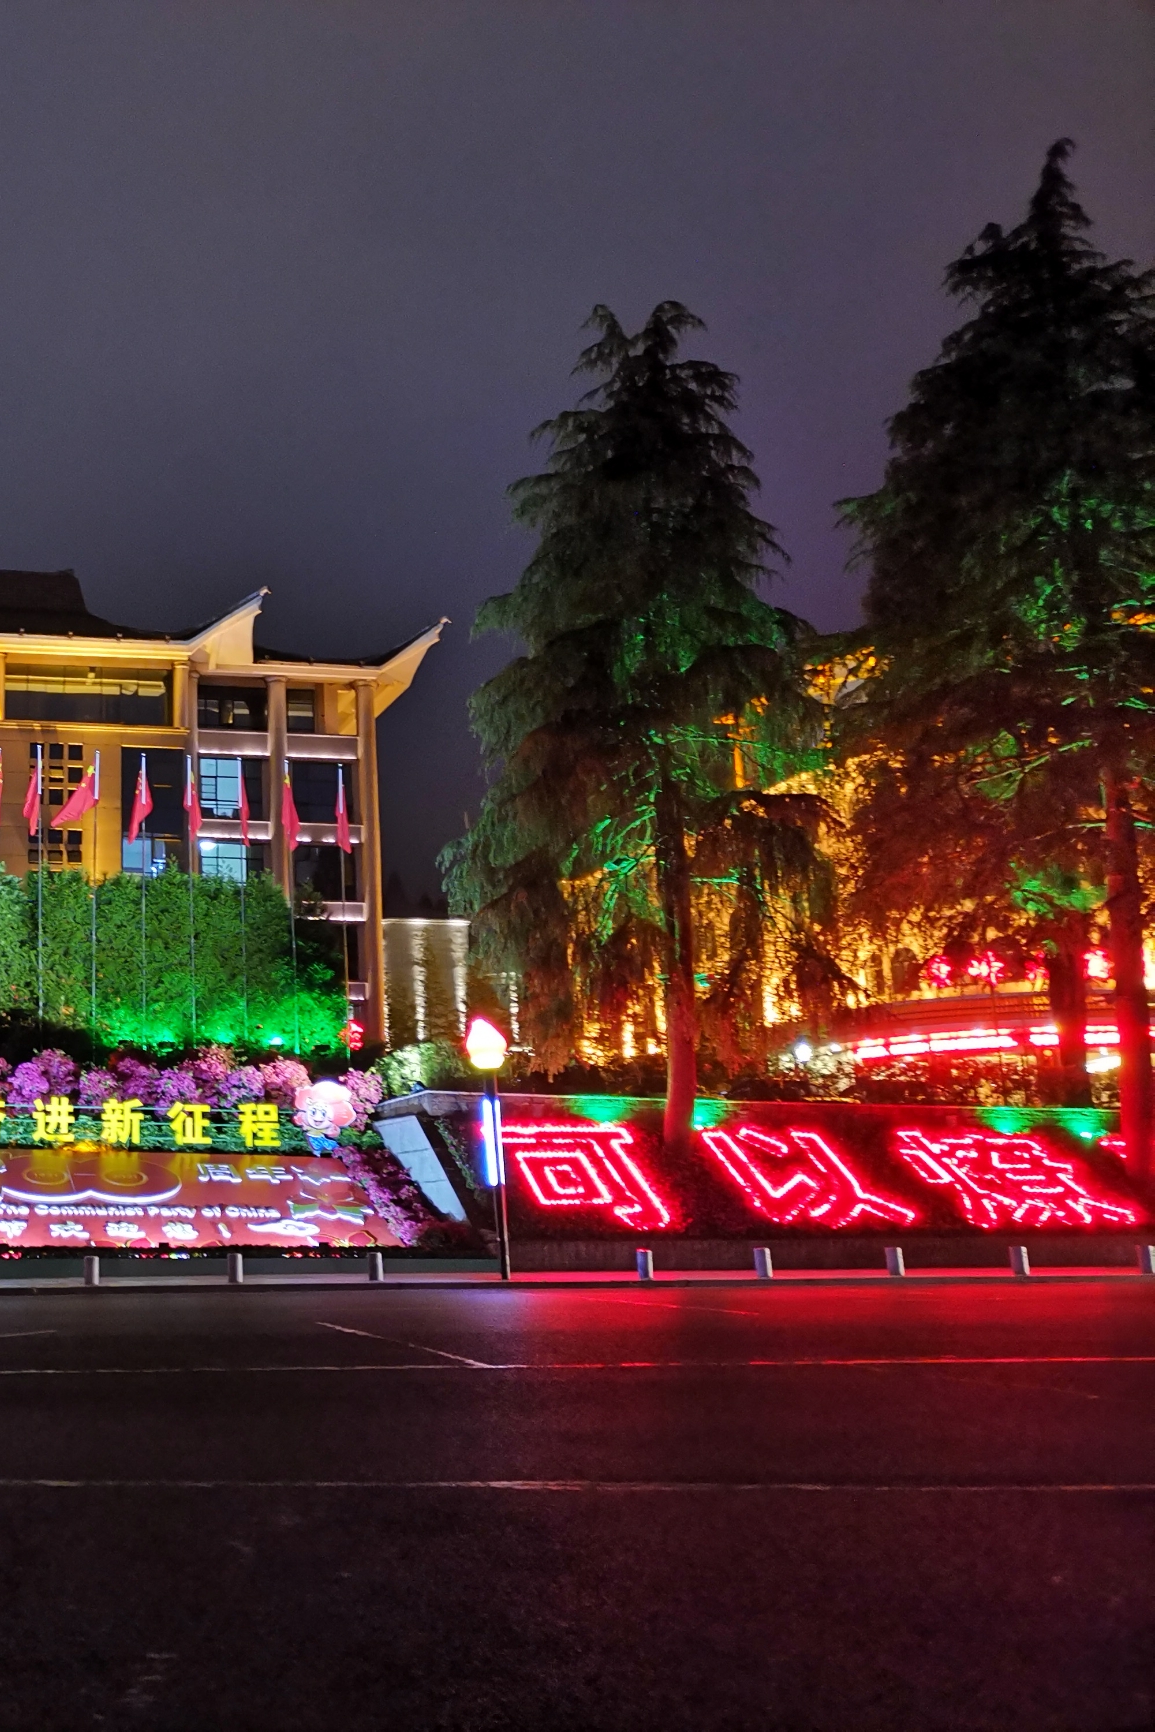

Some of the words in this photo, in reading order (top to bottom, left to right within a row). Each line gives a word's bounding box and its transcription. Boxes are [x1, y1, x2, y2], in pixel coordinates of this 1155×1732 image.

[196, 1163, 294, 1184] 周年
[482, 1122, 1136, 1230] 可以燎
[146, 1205, 197, 1219] Party
[224, 1206, 282, 1219] China
